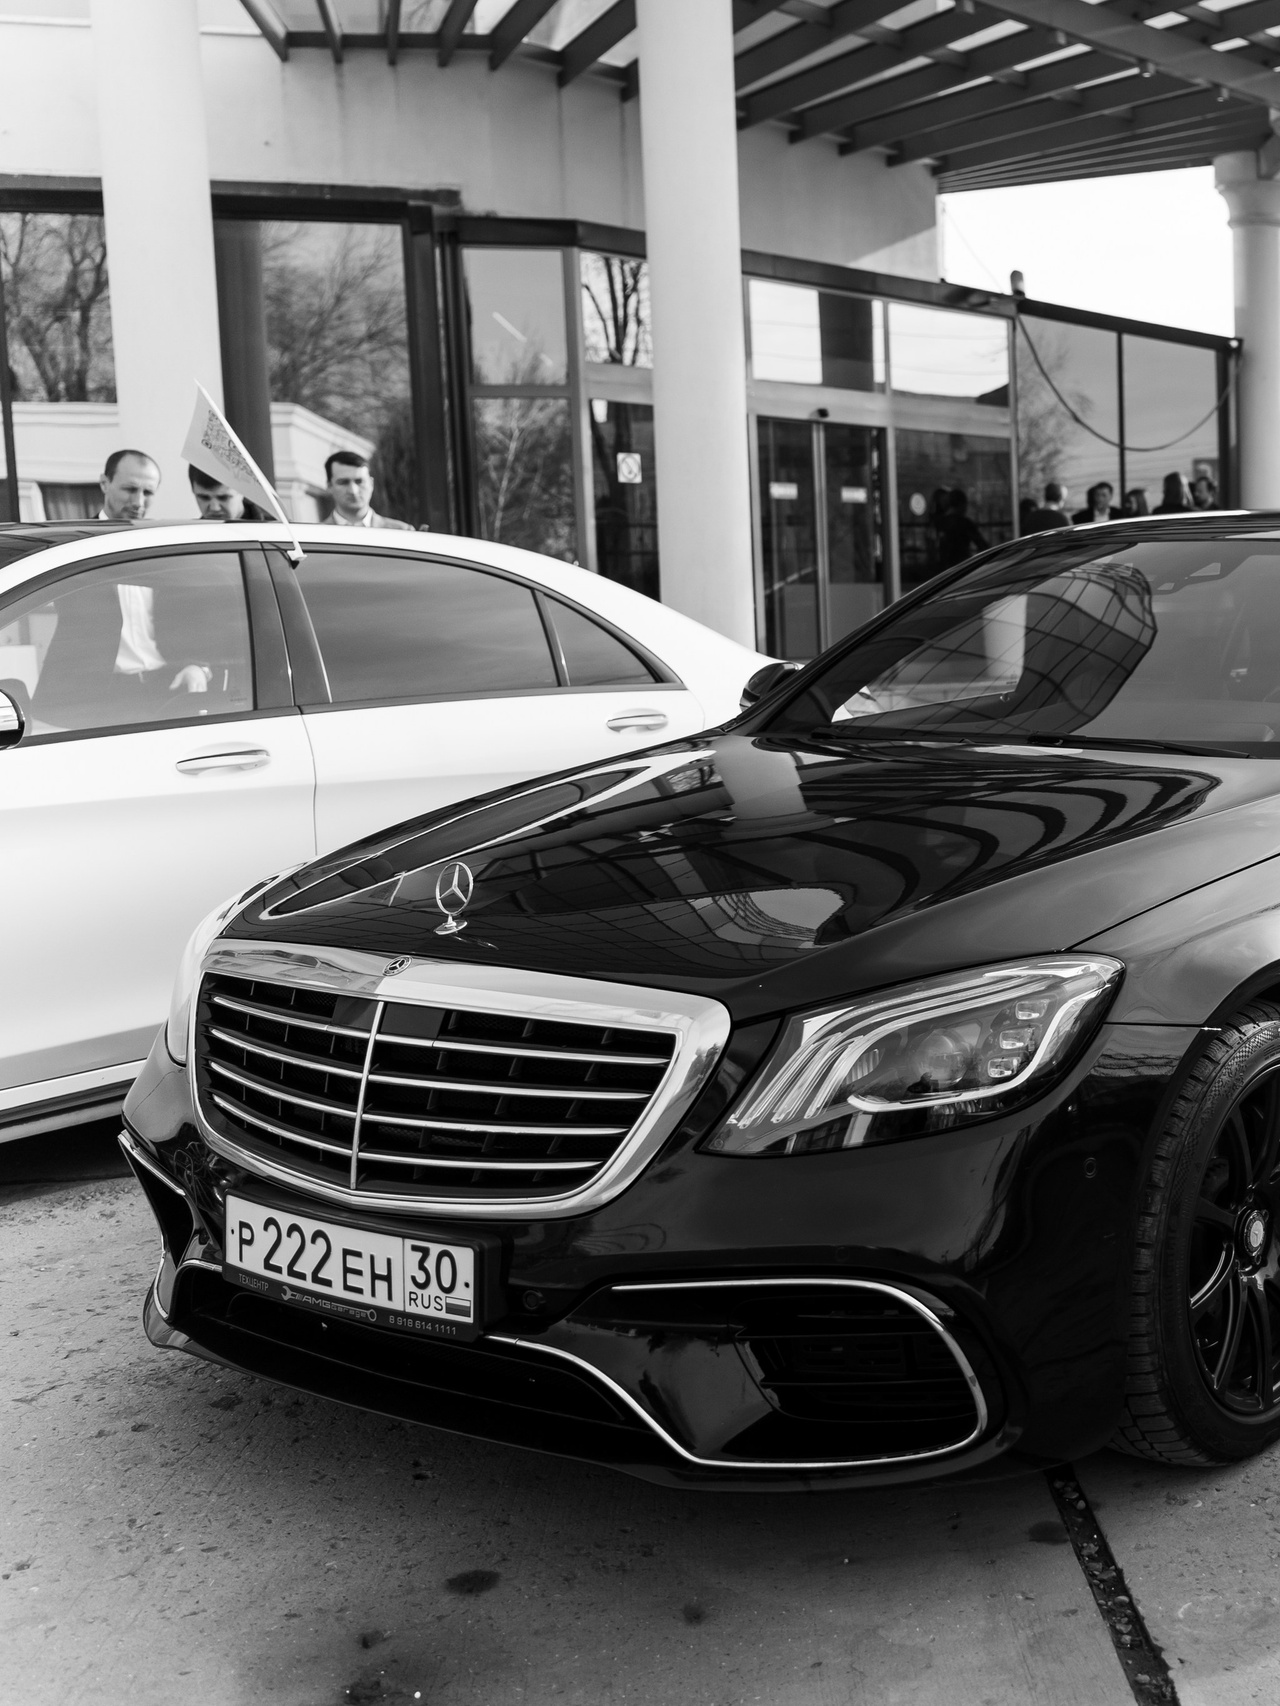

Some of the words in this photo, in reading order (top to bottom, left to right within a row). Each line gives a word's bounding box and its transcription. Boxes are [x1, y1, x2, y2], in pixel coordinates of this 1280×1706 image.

[410, 1243, 458, 1295] 30
[238, 1273, 269, 1292] ТЕХЦЕНТР
[408, 1291, 444, 1312] RUS
[388, 1315, 395, 1324] 8
[435, 1324, 457, 1336] 1111
